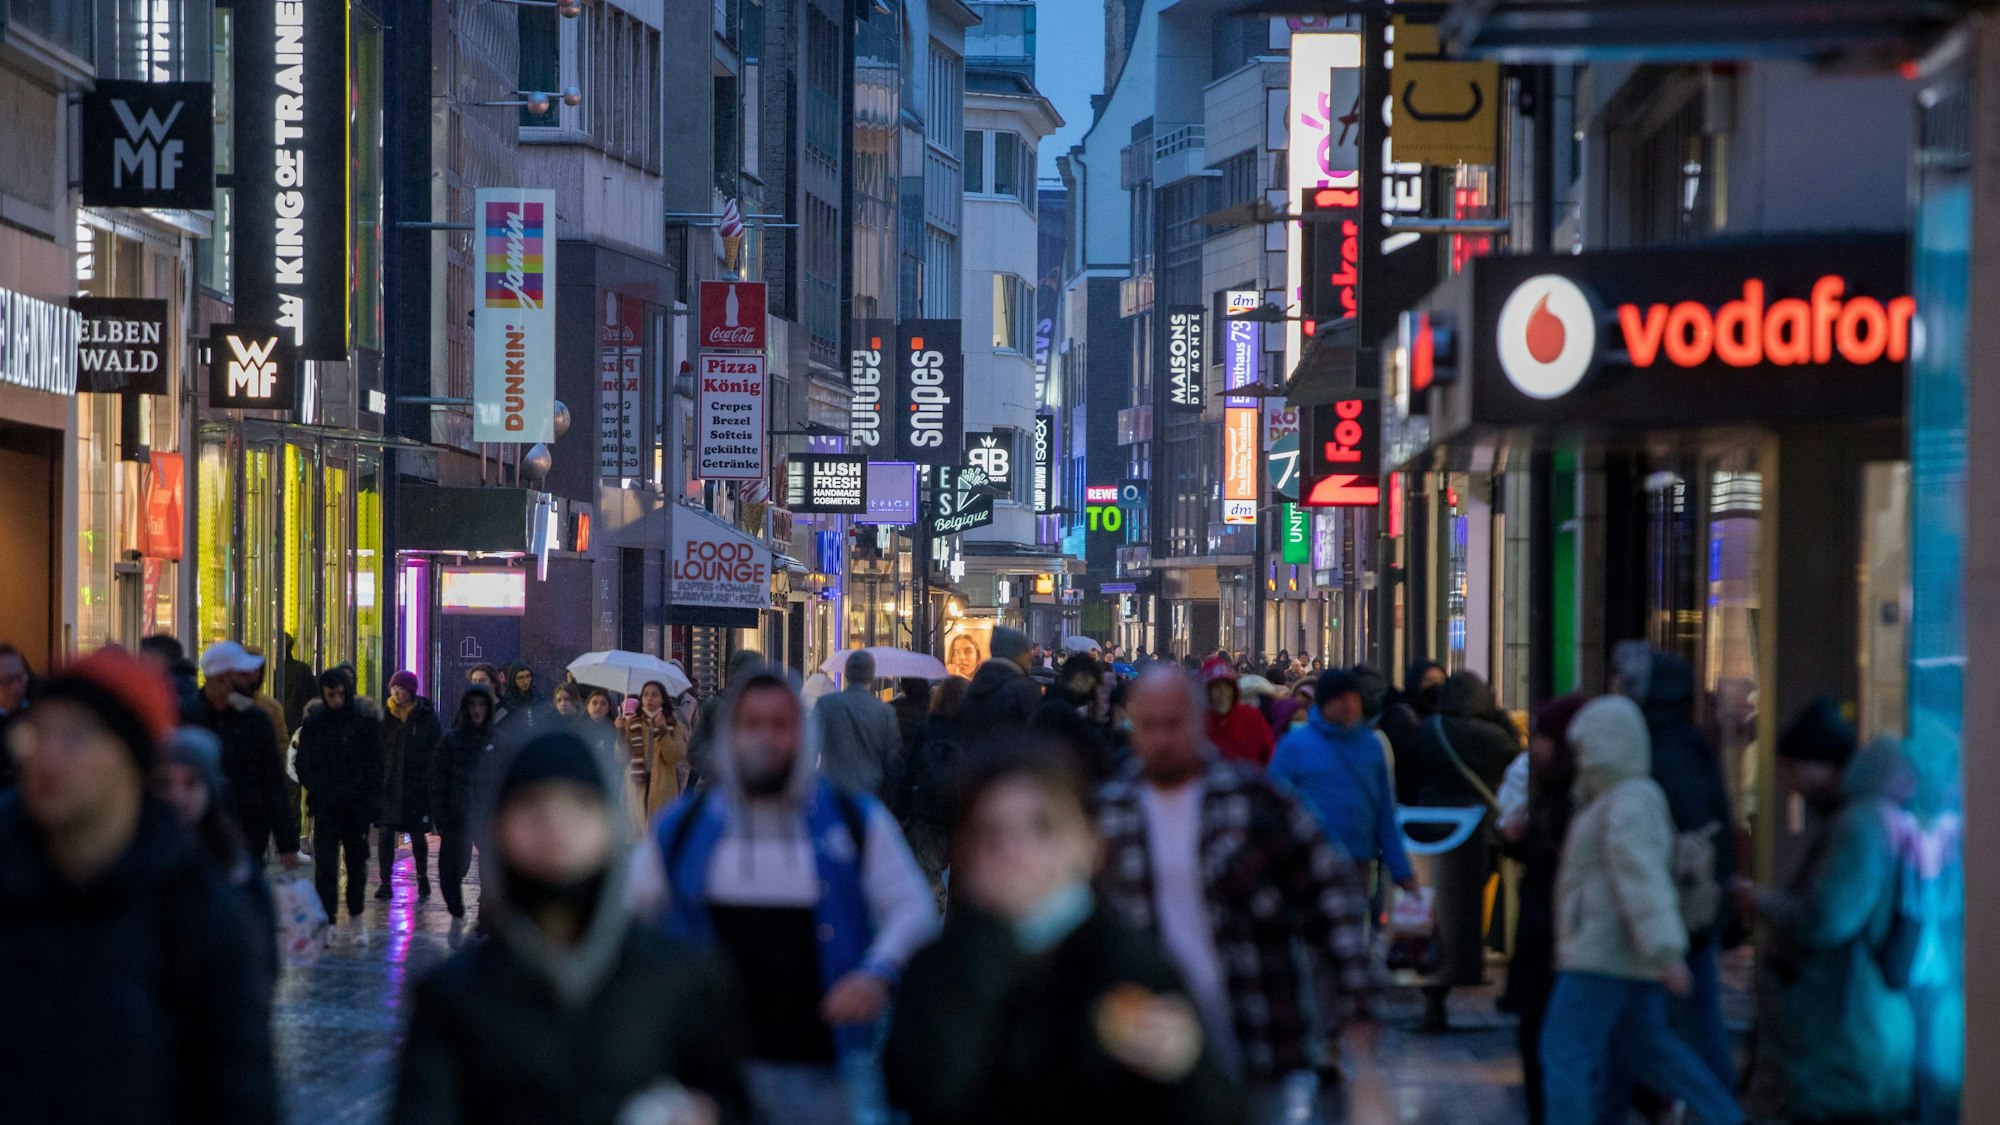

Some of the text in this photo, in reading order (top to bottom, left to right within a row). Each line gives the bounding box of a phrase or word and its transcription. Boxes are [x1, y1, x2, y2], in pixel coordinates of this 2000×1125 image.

[110, 99, 185, 190] WMF
[275, 0, 304, 284] KING OF TRAINE
[497, 210, 538, 309] jamin
[1233, 295, 1254, 306] dm
[79, 320, 162, 344] ELBEN
[1231, 320, 1251, 341] 73
[80, 349, 159, 372] WALD
[226, 335, 278, 398] WMF
[707, 360, 758, 374] Pizza
[1170, 313, 1187, 404] MAISONS
[1191, 314, 1200, 404] DU MONDE
[505, 325, 525, 431] DUNKIN'
[704, 379, 761, 395] König
[711, 402, 752, 412] Crepes
[911, 350, 950, 447] snipes
[712, 416, 750, 425] Brezel
[710, 430, 752, 440] Softeis
[1325, 400, 1363, 463] Foo
[704, 444, 758, 455] gekühlte
[702, 458, 760, 469] Getränke
[813, 462, 862, 476] LUSH
[813, 477, 861, 489] FRESH
[813, 489, 861, 497] HANDMADE
[813, 497, 861, 506] COSMETICS
[1088, 488, 1118, 500] REWE
[1086, 506, 1122, 531] TO
[1231, 504, 1252, 515] dm
[935, 510, 989, 532] Belgique
[686, 541, 754, 562] FOOD
[674, 560, 765, 583] LOUNGE
